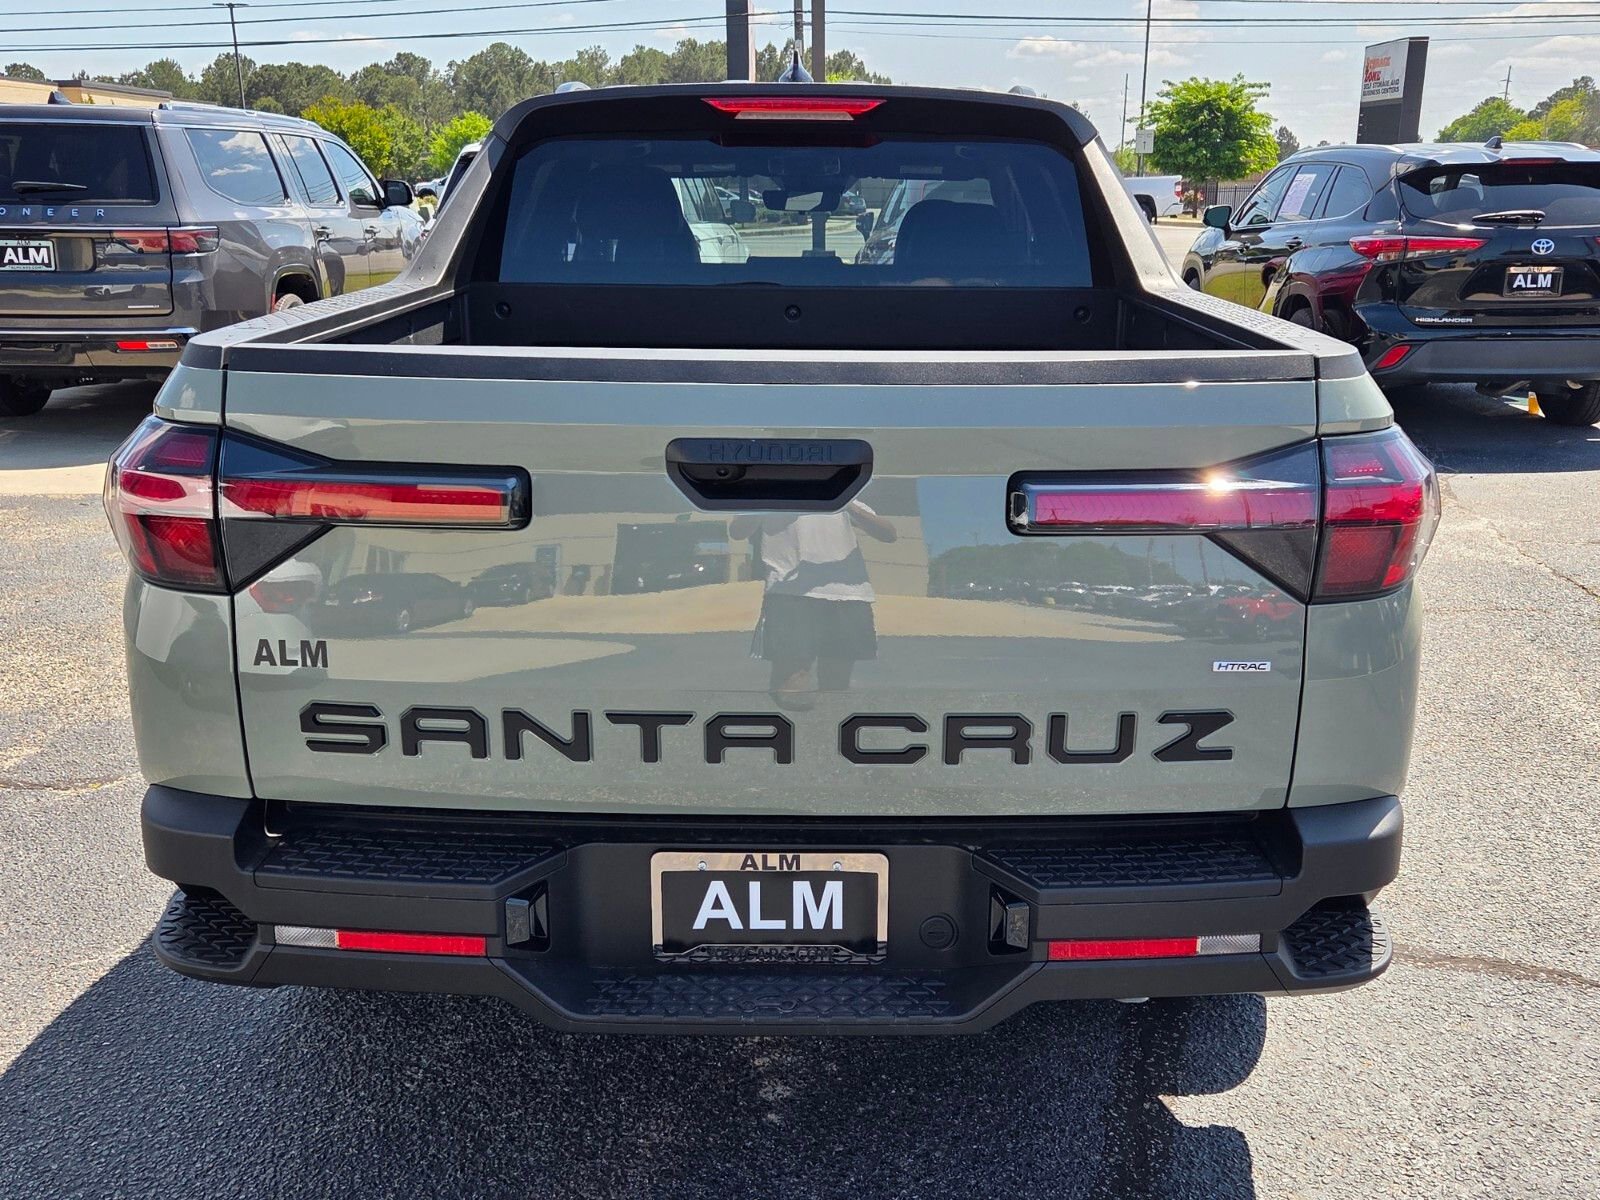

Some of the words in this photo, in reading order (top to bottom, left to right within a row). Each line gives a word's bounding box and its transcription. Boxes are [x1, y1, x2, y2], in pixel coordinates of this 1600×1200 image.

[3, 247, 49, 264] ALM
[1512, 273, 1552, 288] ALM
[709, 442, 833, 463] HYUNDAI
[253, 638, 329, 669] ALM
[1217, 662, 1267, 671] HTRAC
[299, 701, 795, 764] SANTA
[838, 708, 1236, 766] CRUZ
[740, 854, 801, 871] ALM
[692, 880, 844, 930] ALM
